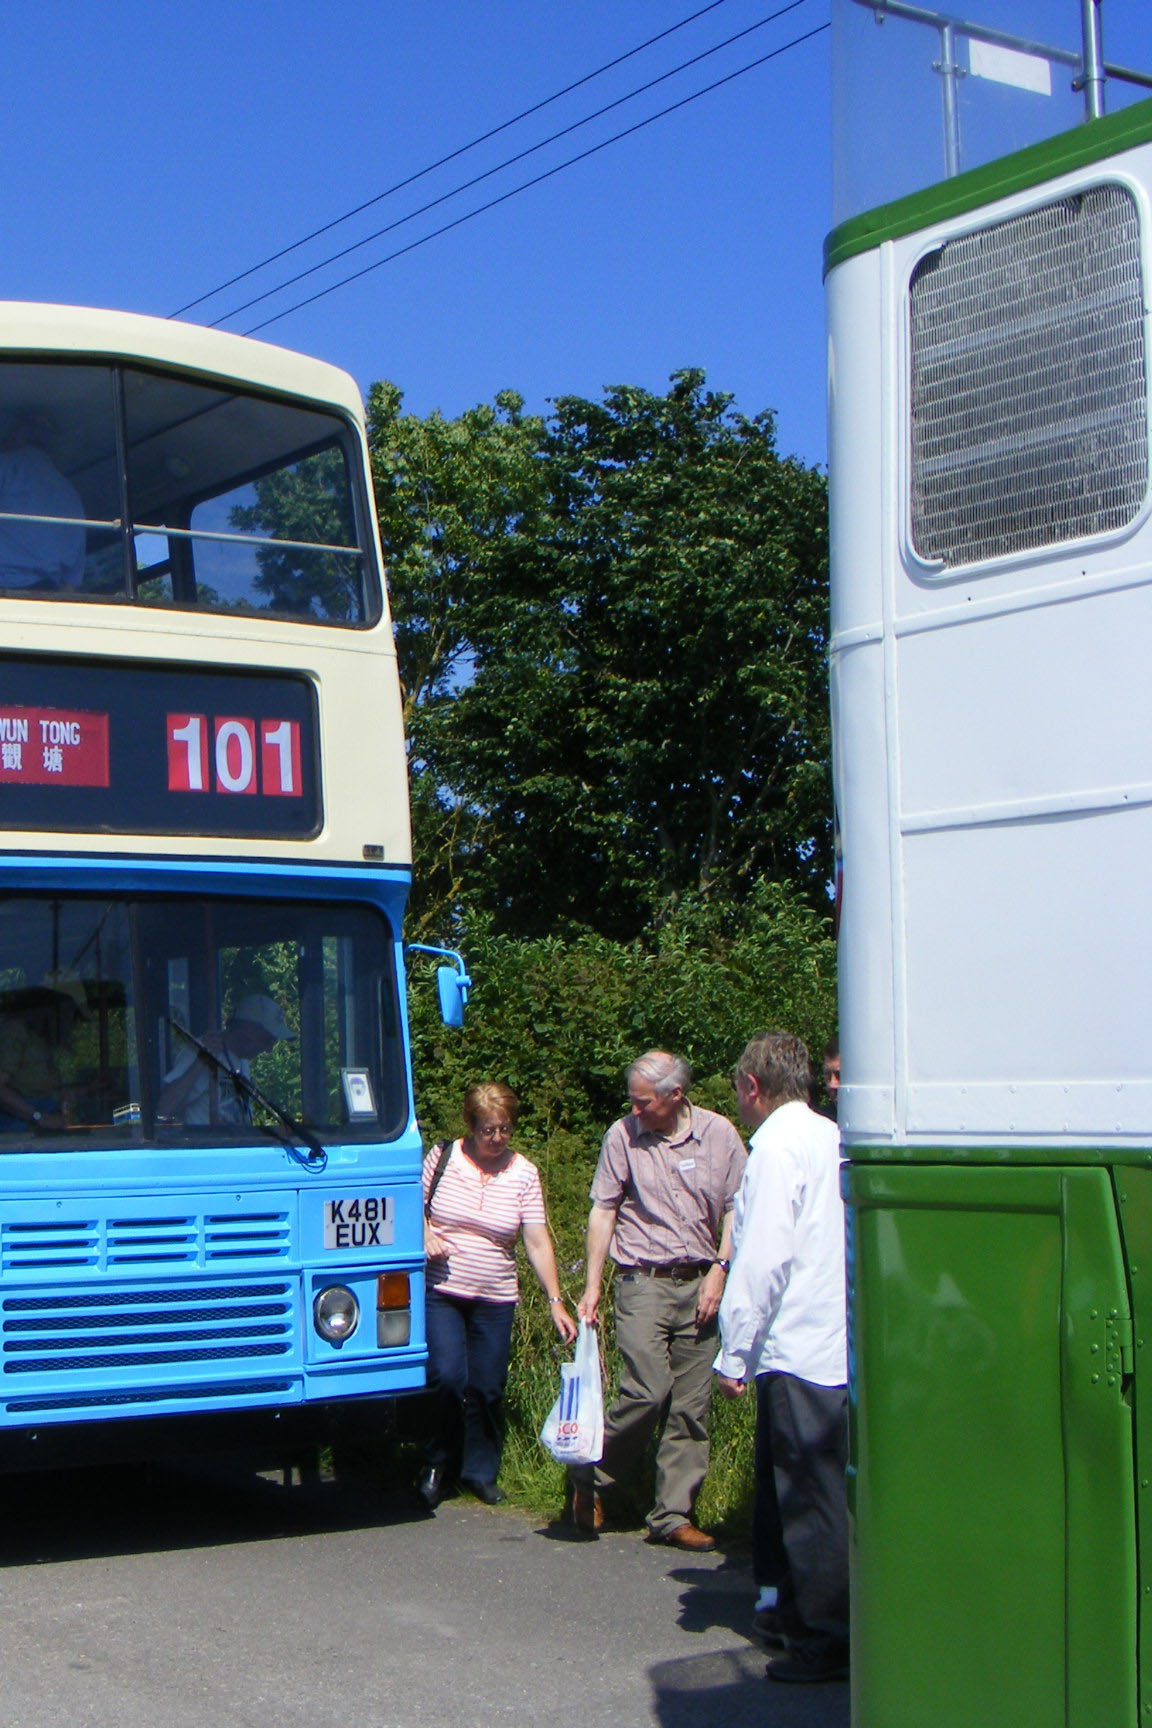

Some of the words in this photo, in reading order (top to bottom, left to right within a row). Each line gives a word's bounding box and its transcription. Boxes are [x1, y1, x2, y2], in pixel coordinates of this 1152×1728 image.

[39, 720, 81, 745] TONG
[173, 717, 294, 793] 101
[331, 1197, 386, 1223] K481
[336, 1222, 380, 1247] EUX
